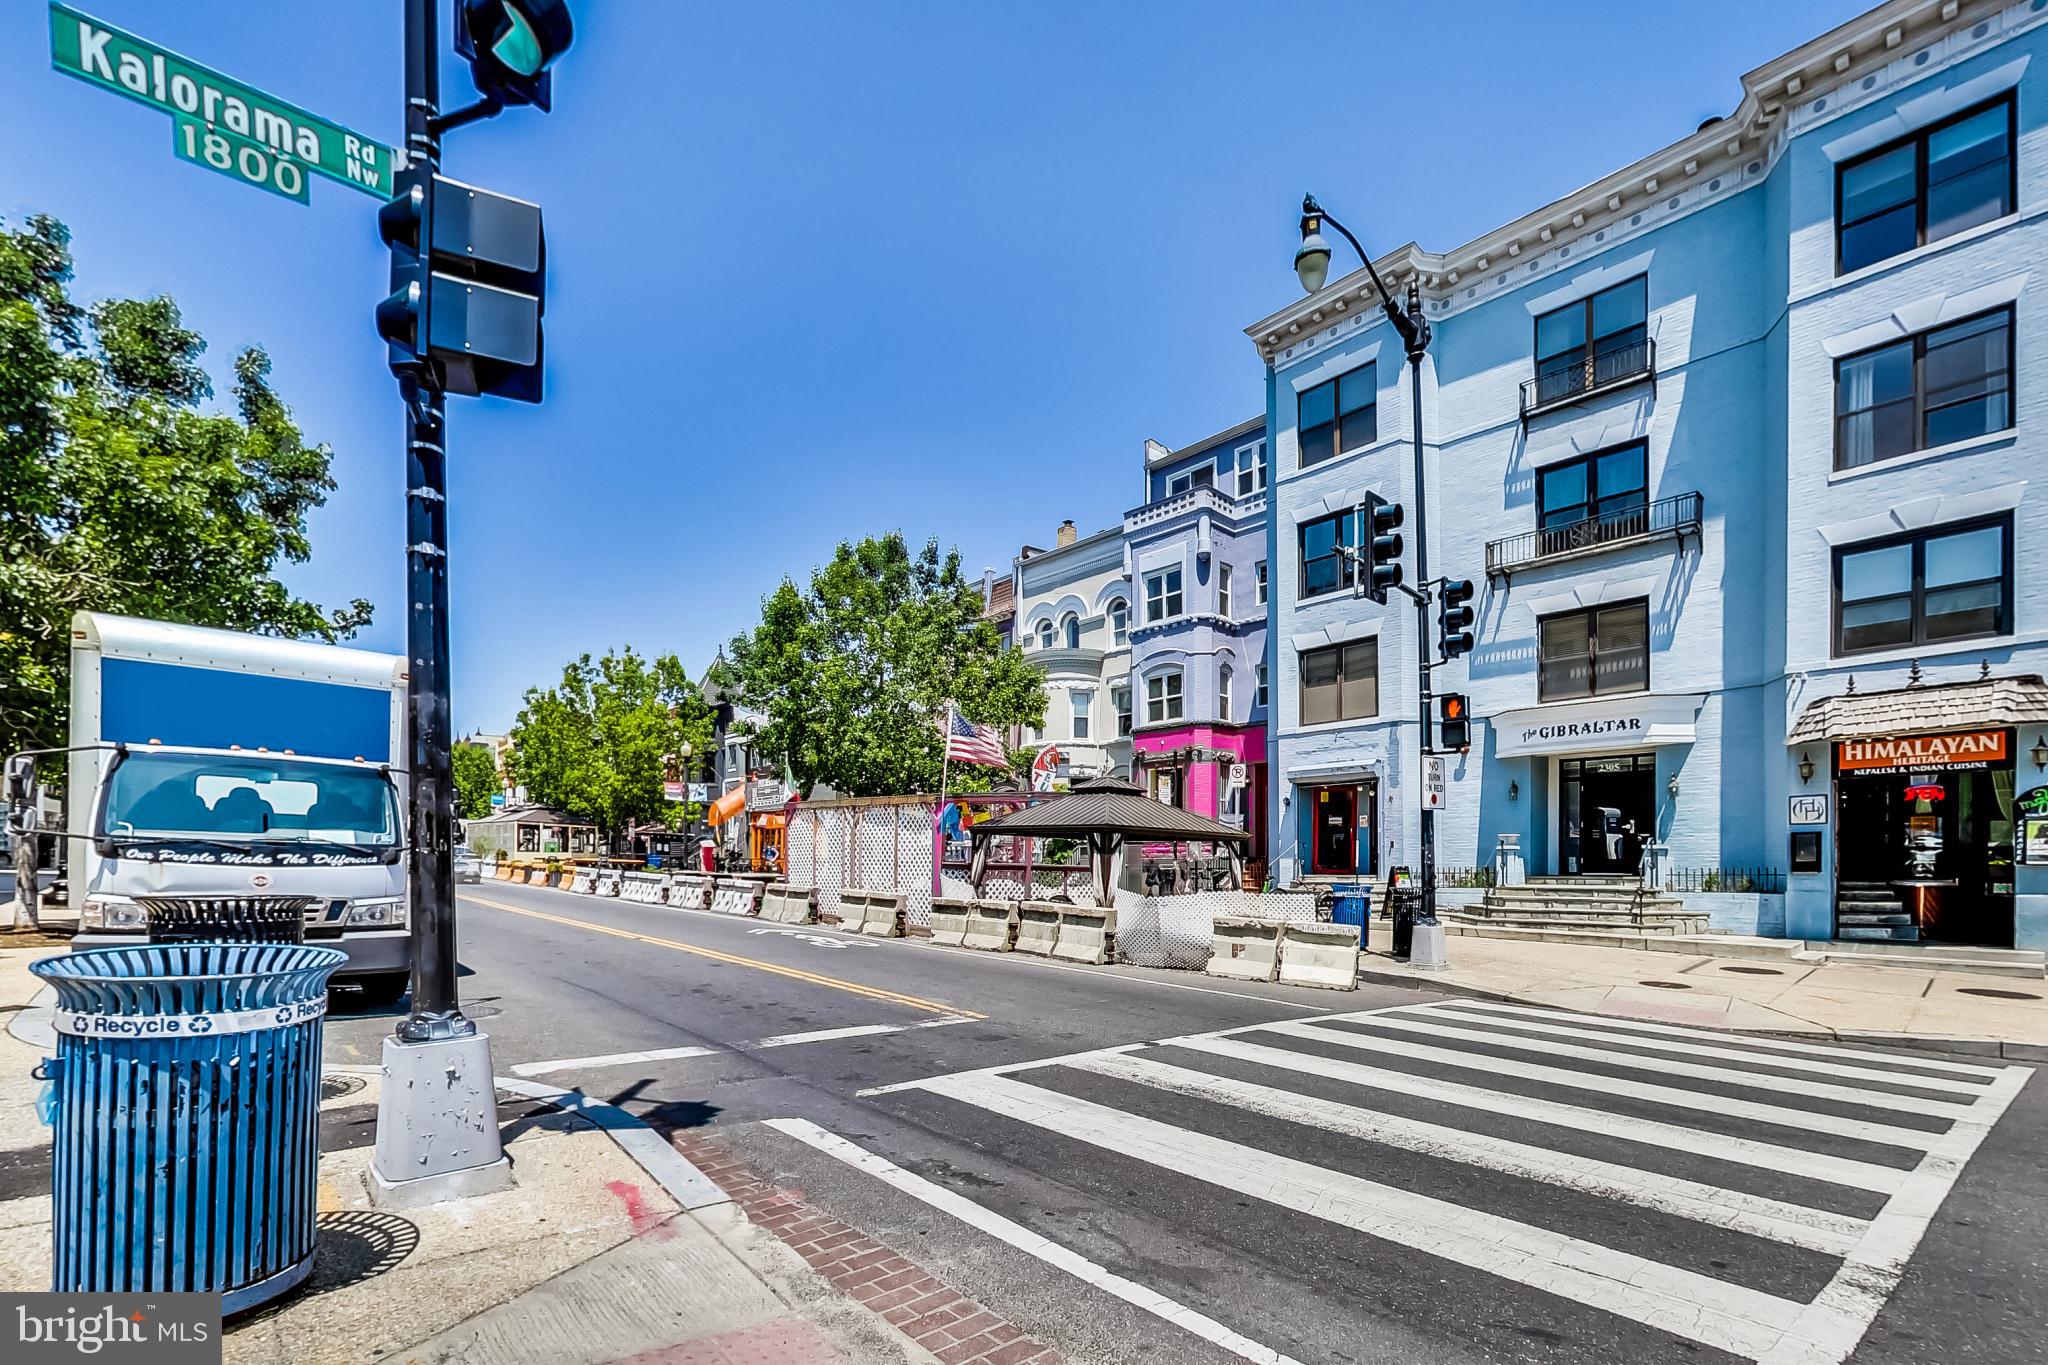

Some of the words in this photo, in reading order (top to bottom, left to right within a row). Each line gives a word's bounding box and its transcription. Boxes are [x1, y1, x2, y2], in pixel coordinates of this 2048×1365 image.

[78, 22, 320, 164] Kalorama
[344, 134, 375, 165] Rd
[182, 125, 302, 195] 1800
[1522, 729, 1537, 742] The
[1540, 718, 1641, 739] GIBRALTAR
[1845, 734, 1999, 761] HIMALAYAN
[1429, 761, 1439, 771] NO
[1893, 754, 1951, 766] HERITAGE
[1598, 763, 1620, 772] 2305
[1854, 766, 1897, 775] NEPALESE
[1910, 764, 1944, 773] INDIAN
[1947, 761, 1987, 770] CUISINE
[1428, 773, 1440, 781] TURN
[1434, 784, 1443, 792] RED
[126, 849, 154, 860] Our
[158, 850, 216, 863] People
[220, 853, 273, 864] Make
[276, 853, 307, 864] The
[94, 1018, 180, 1036] Recycle
